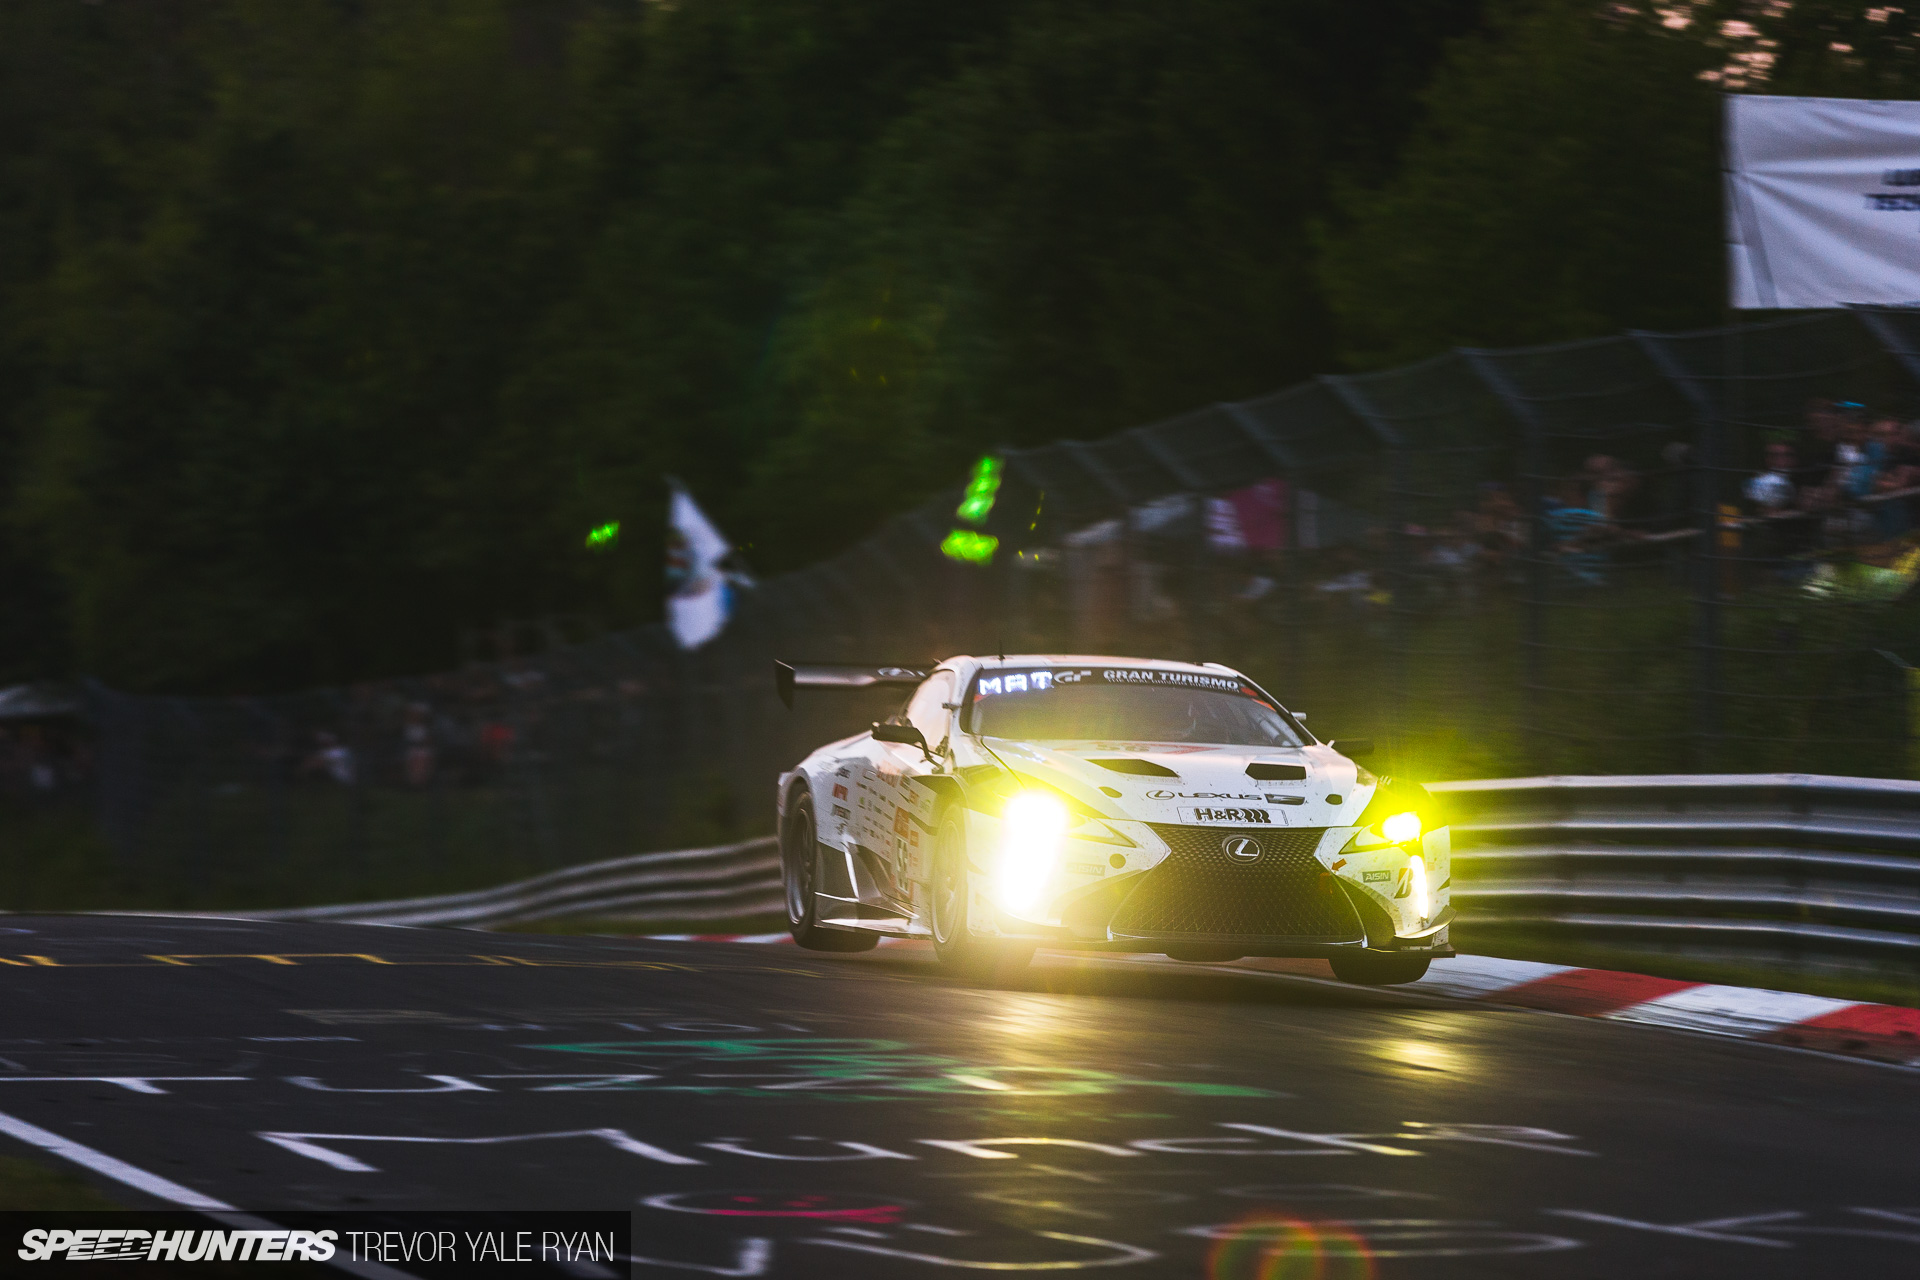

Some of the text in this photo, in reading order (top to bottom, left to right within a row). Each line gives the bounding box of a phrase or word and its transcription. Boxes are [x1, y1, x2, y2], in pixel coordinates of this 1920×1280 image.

[1103, 669, 1153, 681] GRAN
[1159, 672, 1239, 690] TURISMO
[1177, 791, 1263, 801] LEXUS
[1194, 807, 1241, 822] H&R
[1364, 872, 1390, 882] AISIN
